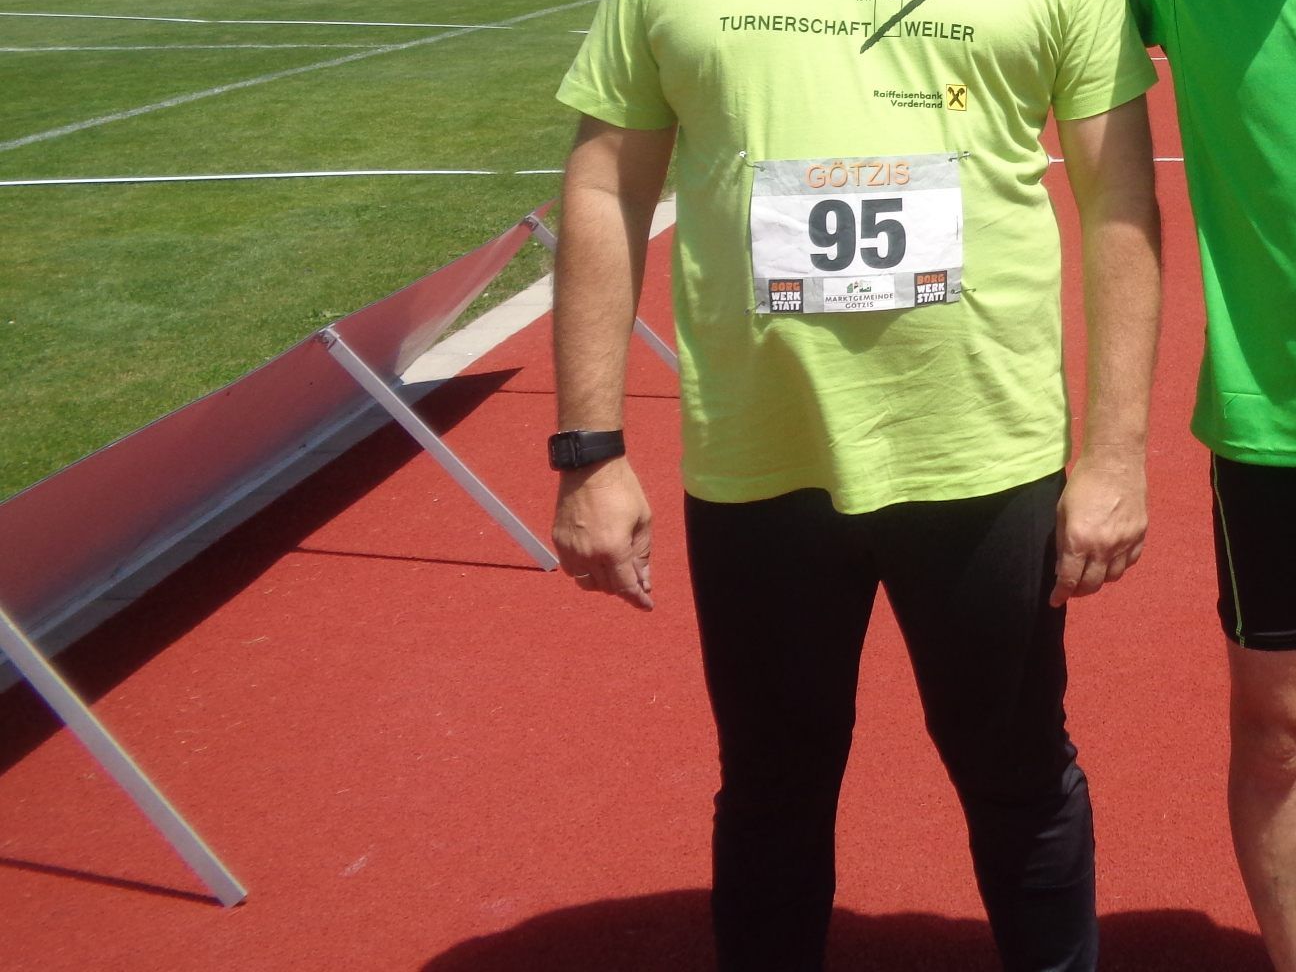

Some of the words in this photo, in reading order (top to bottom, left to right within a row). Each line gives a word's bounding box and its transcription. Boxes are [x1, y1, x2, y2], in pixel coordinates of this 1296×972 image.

[720, 15, 872, 36] TURNERSCHAFT
[904, 21, 975, 42] WEILER
[873, 90, 943, 100] Raiffeisenbank
[890, 99, 943, 109] Vorderland
[806, 162, 912, 189] GÖTZIS
[808, 197, 907, 272] 95
[916, 282, 946, 295] WERK
[771, 290, 802, 302] WERK
[825, 293, 894, 303] MARKTGEMEINDE
[916, 291, 946, 304] STATT
[771, 300, 802, 312] STATT
